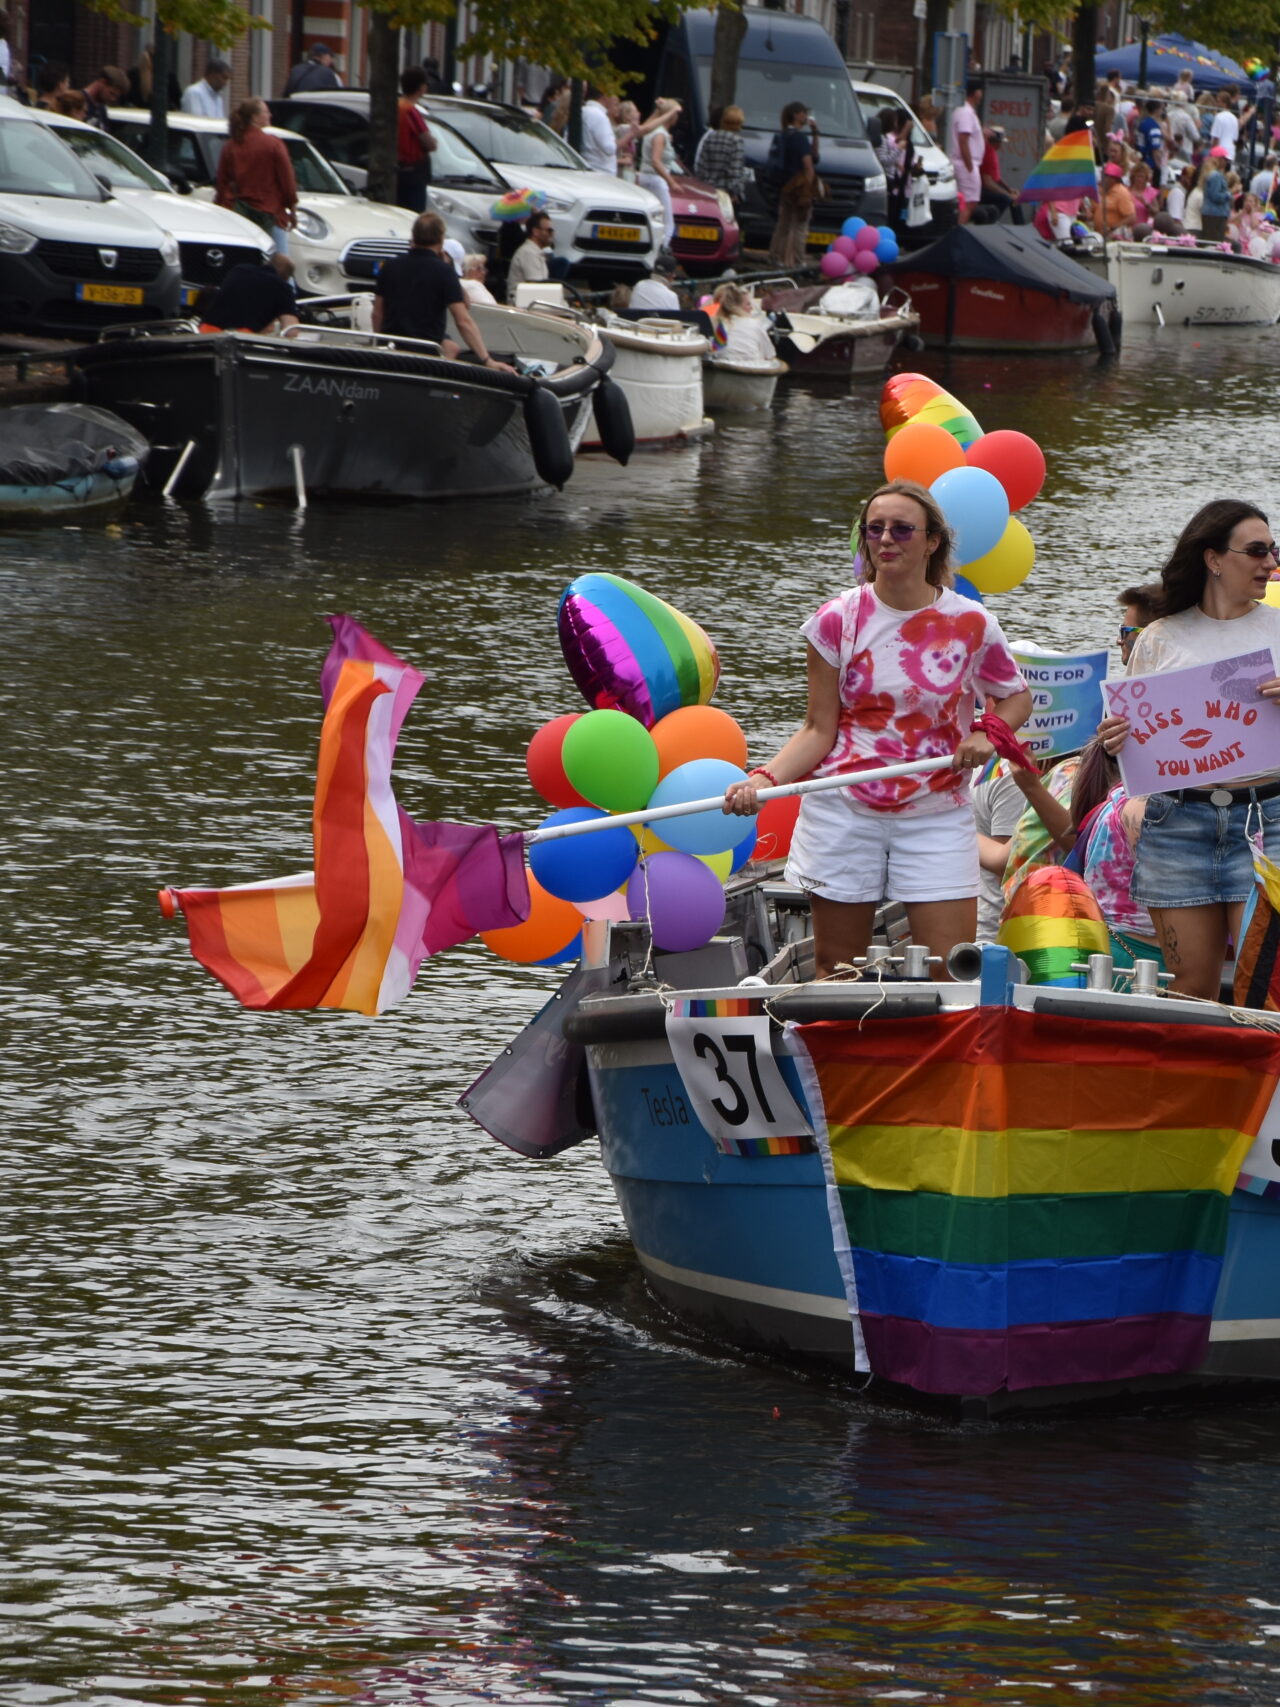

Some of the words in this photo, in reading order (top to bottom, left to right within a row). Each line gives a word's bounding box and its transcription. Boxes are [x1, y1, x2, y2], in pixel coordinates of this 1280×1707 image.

[283, 372, 381, 400] ZAANdam
[1020, 667, 1050, 681] ING
[1054, 669, 1085, 681] FOR
[1035, 713, 1074, 728] WITH
[1130, 708, 1184, 745] KISS
[1205, 700, 1258, 726] WHO
[1155, 759, 1190, 776] YOU
[1193, 741, 1246, 774] WANT
[692, 1032, 777, 1126] 37
[640, 1085, 689, 1127] Tesla
